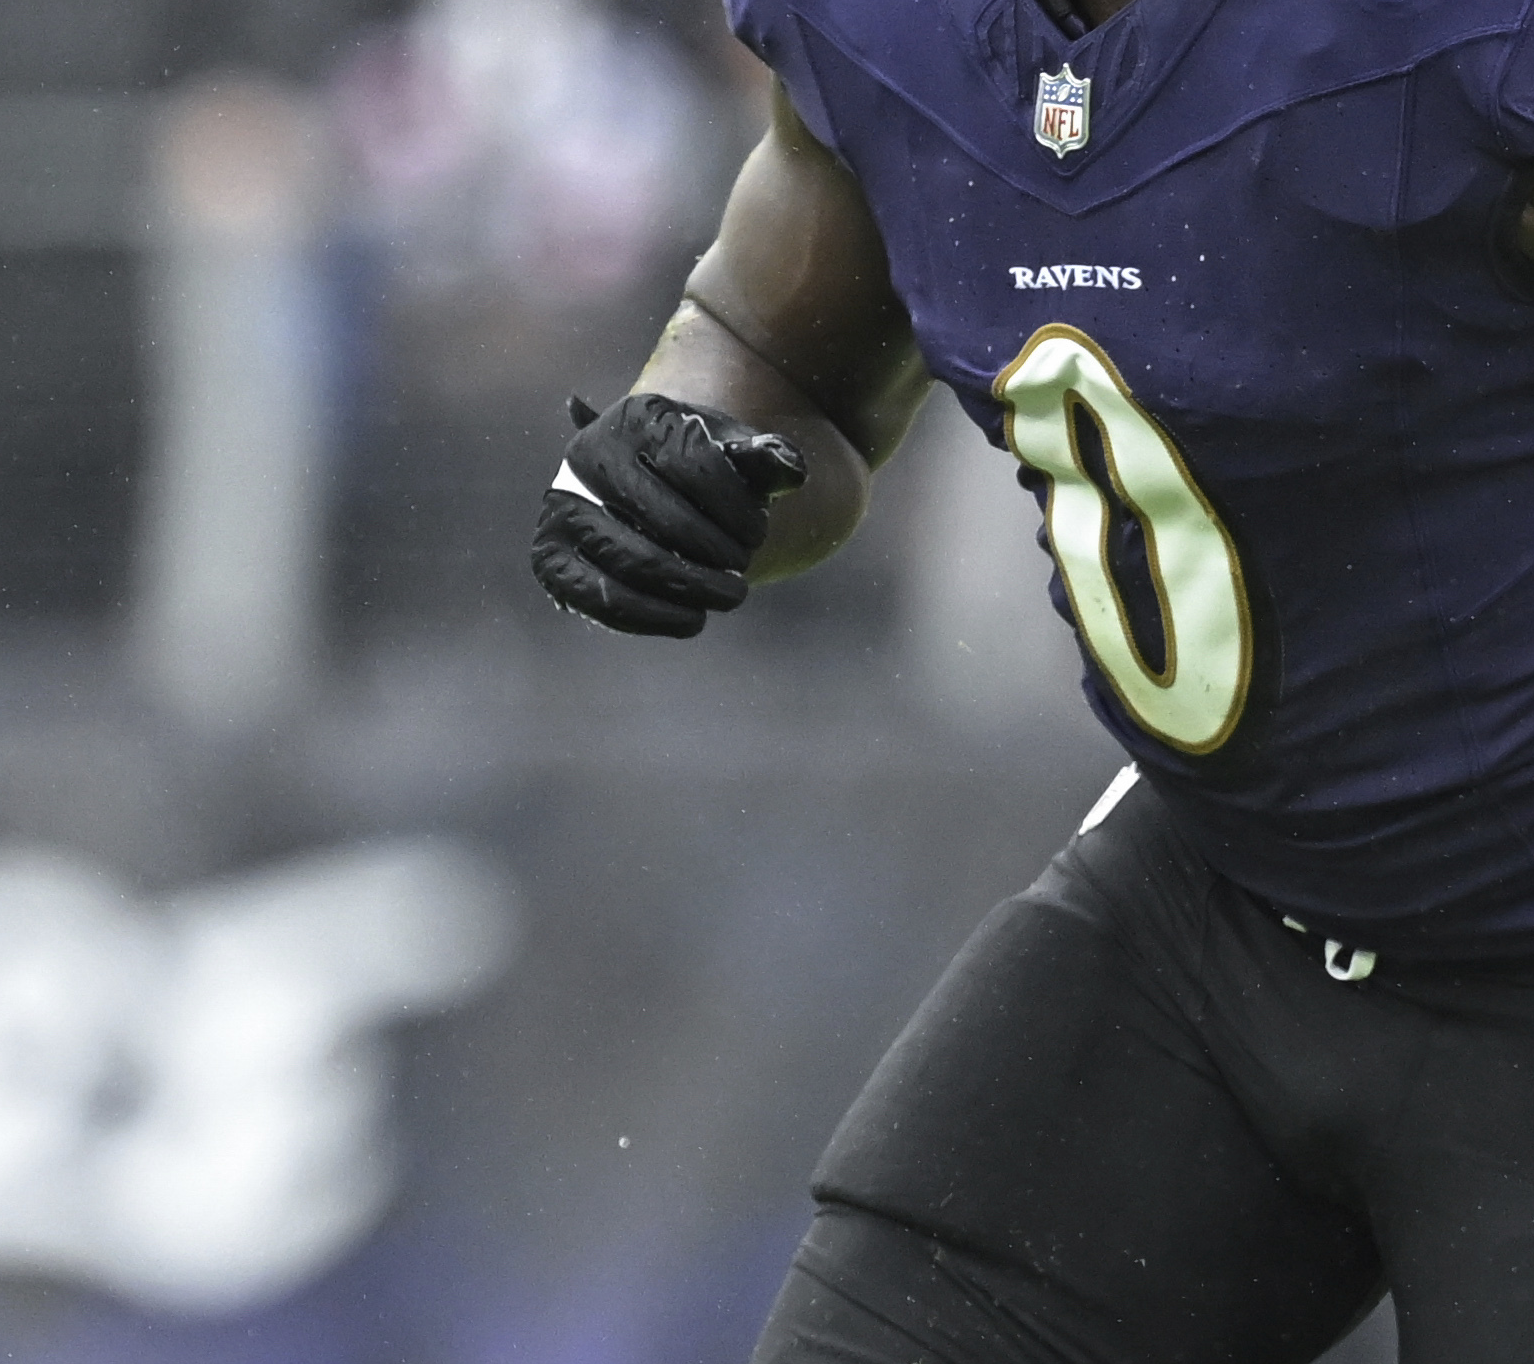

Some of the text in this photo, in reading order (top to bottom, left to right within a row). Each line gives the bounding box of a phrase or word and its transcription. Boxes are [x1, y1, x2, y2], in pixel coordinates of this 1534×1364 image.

[1042, 106, 1080, 141] NFL
[1008, 264, 1143, 291] RAVENS
[992, 323, 1254, 755] 0
